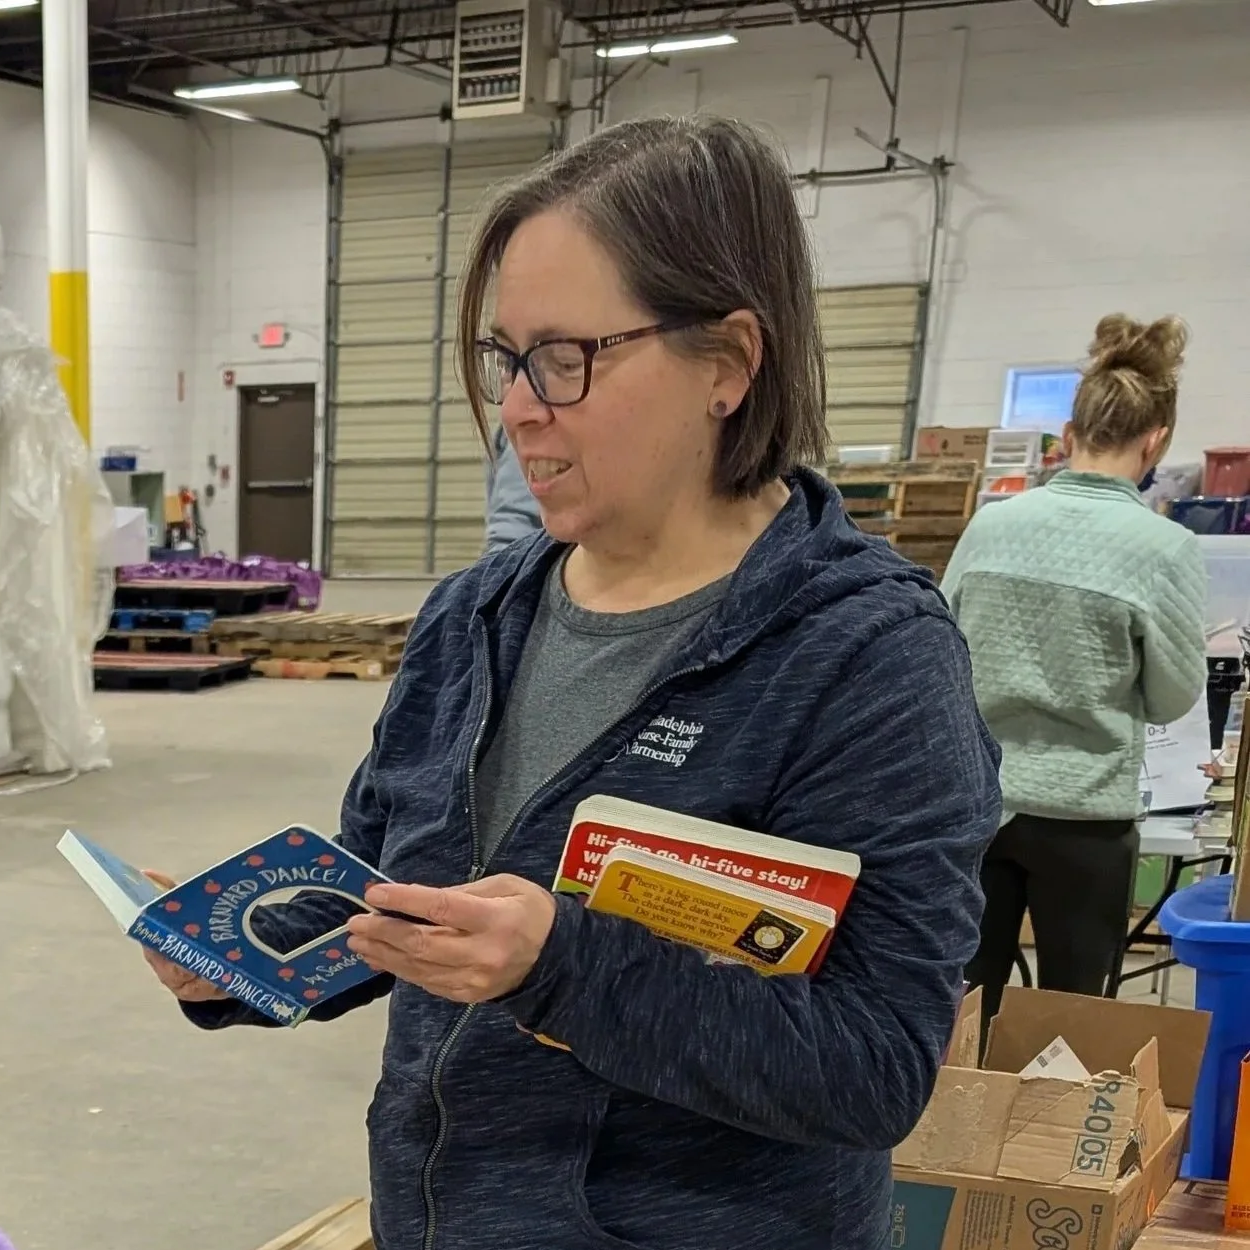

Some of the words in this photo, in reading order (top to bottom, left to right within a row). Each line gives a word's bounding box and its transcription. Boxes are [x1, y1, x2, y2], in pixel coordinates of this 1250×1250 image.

[690, 855, 753, 878] hi-five
[758, 870, 810, 890] stay!
[210, 878, 258, 944] BARNYARD
[258, 866, 349, 886] DANCE!
[621, 892, 639, 903] The
[641, 899, 682, 917] chickens
[683, 914, 700, 922] are
[675, 889, 691, 901] big
[692, 896, 720, 909] round
[721, 905, 749, 918] moon
[689, 905, 710, 916] dark
[634, 906, 650, 916] Do
[650, 912, 669, 923] you
[670, 918, 695, 931] know
[699, 926, 725, 940] why?
[160, 935, 224, 981] BARNYARD
[226, 971, 275, 1010] DANCE!
[302, 972, 321, 986] by
